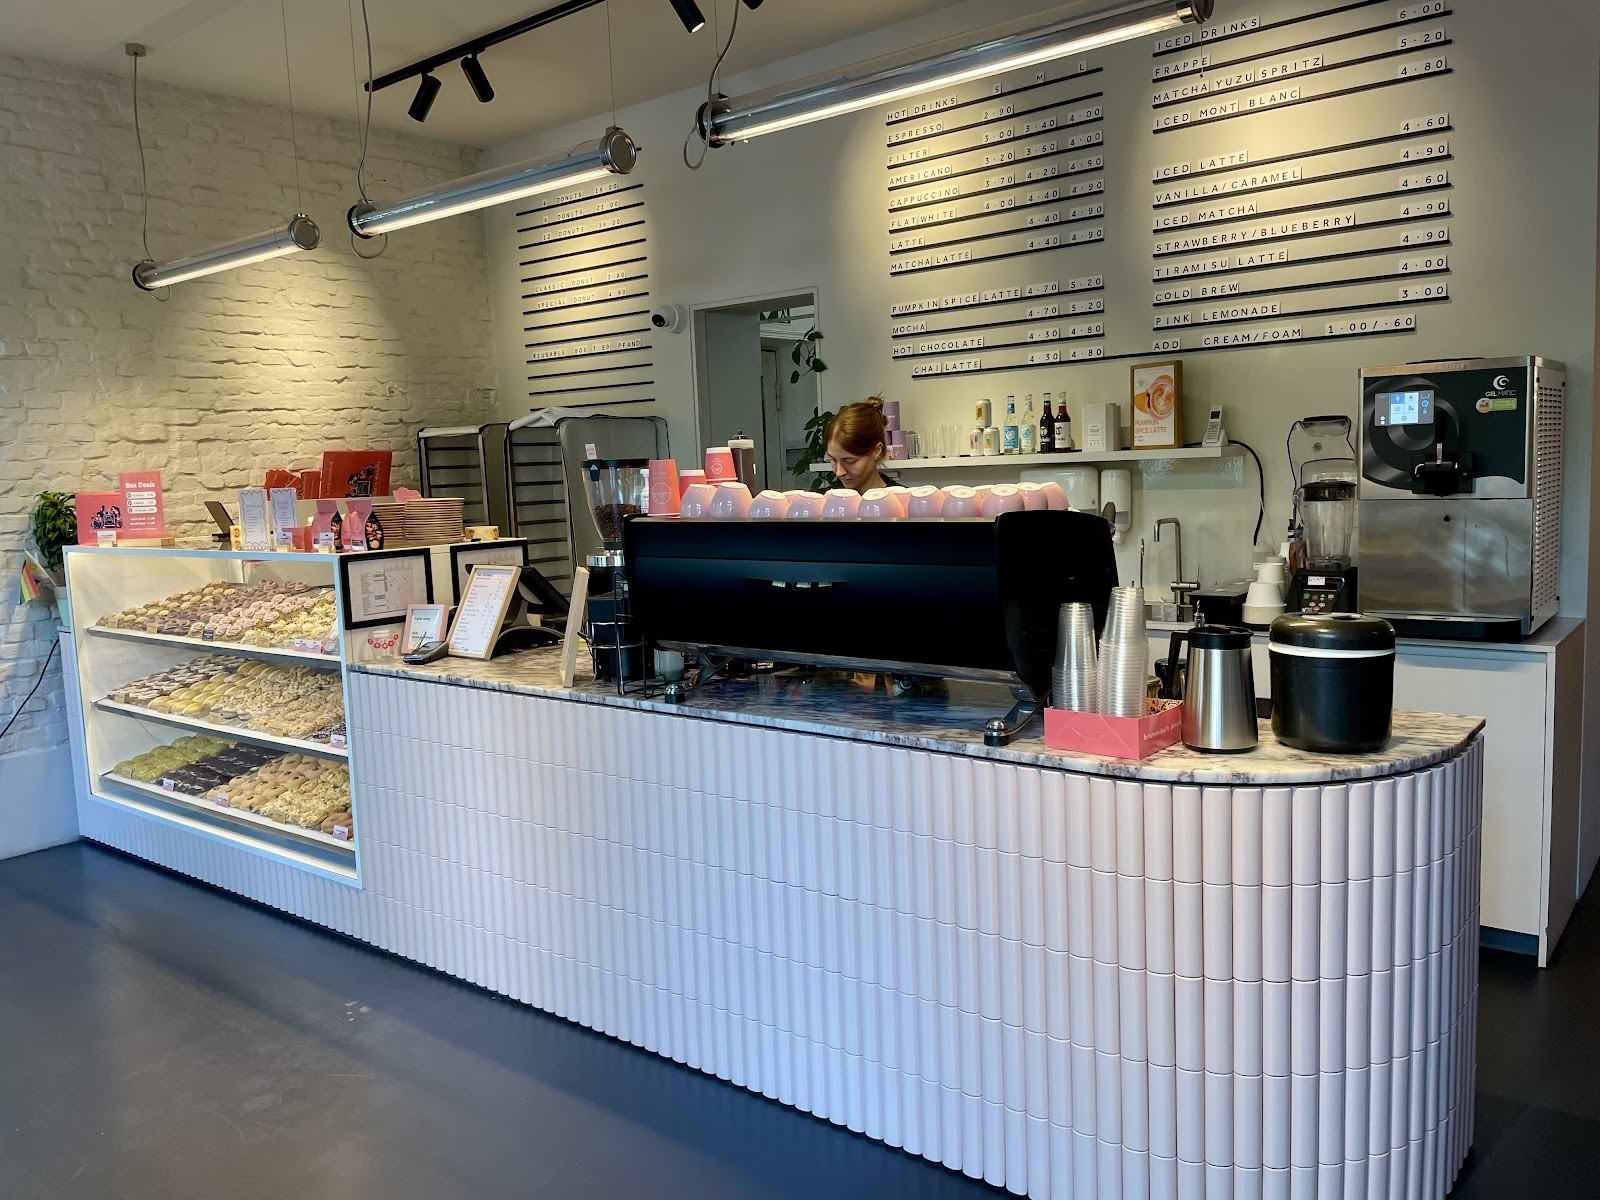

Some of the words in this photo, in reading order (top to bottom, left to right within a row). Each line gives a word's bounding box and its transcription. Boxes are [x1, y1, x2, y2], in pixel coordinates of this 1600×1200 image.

[1158, 35, 1191, 50] ICED
[1201, 18, 1257, 39] DRINKS
[1155, 57, 1208, 77] FRAPPE
[1153, 83, 1208, 103] MATCHA
[1216, 73, 1252, 88] YUZU
[1261, 57, 1320, 78] SPRITZ
[887, 109, 906, 121] HOT
[914, 97, 955, 114] DRINKS
[1156, 113, 1189, 127] ICED
[1200, 103, 1236, 118] MONT
[1249, 89, 1297, 107] BLANC
[888, 123, 942, 143] ESPRESSO
[889, 149, 928, 164] FILTER
[1156, 164, 1189, 178] ICED
[1200, 154, 1245, 169] LATTE
[890, 166, 951, 186] AMERICANO
[890, 187, 958, 207] CAPPUCCINO
[1156, 171, 1299, 203] VANILLA/CARAMEL
[557, 193, 581, 203] DONUTS
[557, 210, 582, 220] DONUTS
[891, 217, 916, 228] FLAT
[921, 209, 954, 222] WHITE
[1156, 215, 1189, 227] ICED
[1198, 205, 1255, 220] MATCHA
[559, 227, 584, 237] DONUTS
[1156, 215, 1352, 252] STRAWBERRY/BLUEBERRY
[891, 237, 923, 250] LATTE
[891, 258, 930, 271] MATCHA
[936, 251, 970, 264] LATTE
[1156, 260, 1228, 277] TIRAMISU
[1238, 252, 1285, 266] LATTE
[535, 283, 564, 293] CLASSIC
[572, 277, 593, 287] DONUT
[1156, 290, 1190, 301] COLD
[1201, 283, 1238, 296] BREW
[537, 300, 565, 309] SPECIAL
[573, 294, 595, 303] DONUT
[892, 300, 938, 313] PUMPKIN
[944, 295, 977, 306] SPICE
[984, 289, 1019, 300] LATTE
[1156, 314, 1189, 325] PINK
[1202, 304, 1278, 321] LEMONADE
[892, 323, 925, 334] MOCHA
[893, 346, 912, 355] HOT
[920, 338, 983, 352] CHOCOLATE
[1154, 341, 1179, 350] ADD
[1204, 328, 1301, 346] CREAM/FOAM
[533, 350, 565, 359] REUSABLE
[914, 364, 939, 374] CHAI
[945, 360, 979, 371] LATTE
[1150, 426, 1168, 434] LATTE
